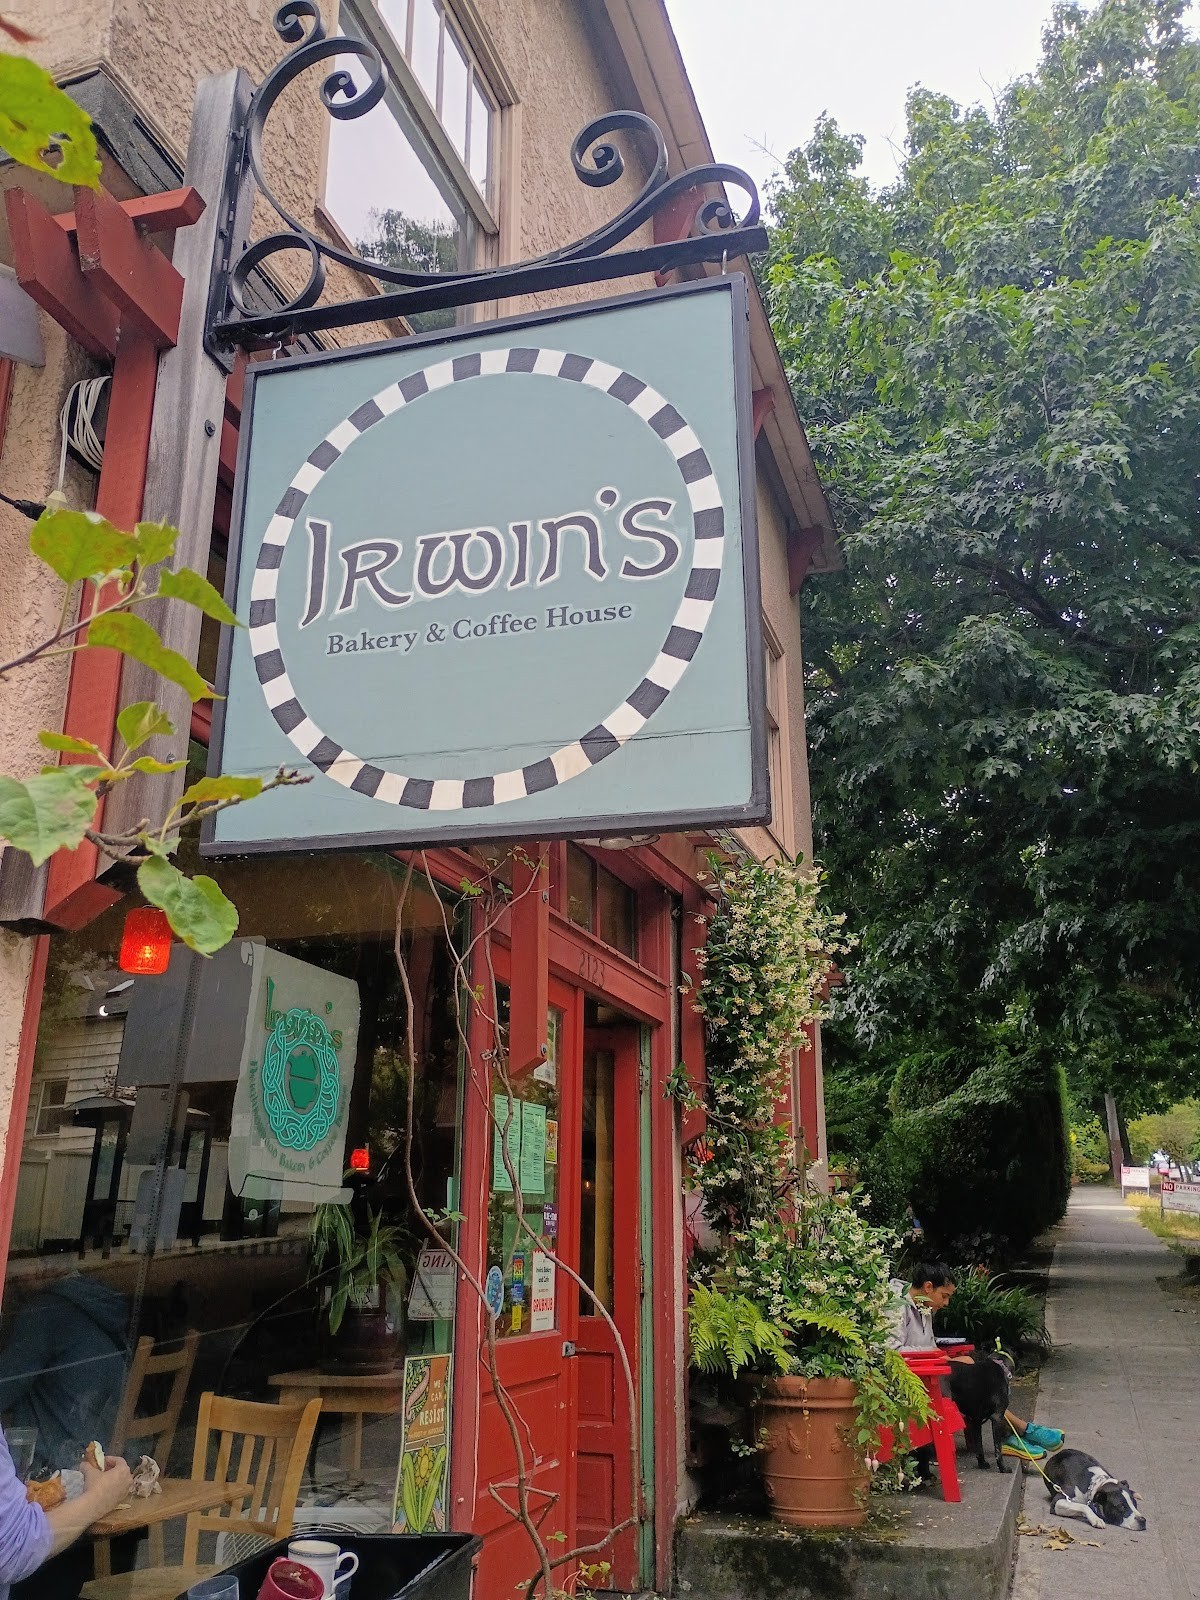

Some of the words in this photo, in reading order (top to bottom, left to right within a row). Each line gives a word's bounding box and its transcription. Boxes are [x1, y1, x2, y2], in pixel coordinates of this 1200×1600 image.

[326, 631, 418, 655] Bakery
[426, 623, 446, 643] &
[452, 615, 537, 640] Coffee
[546, 602, 632, 628] House
[1163, 1182, 1174, 1191] NO
[419, 1407, 445, 1427] RESIST
